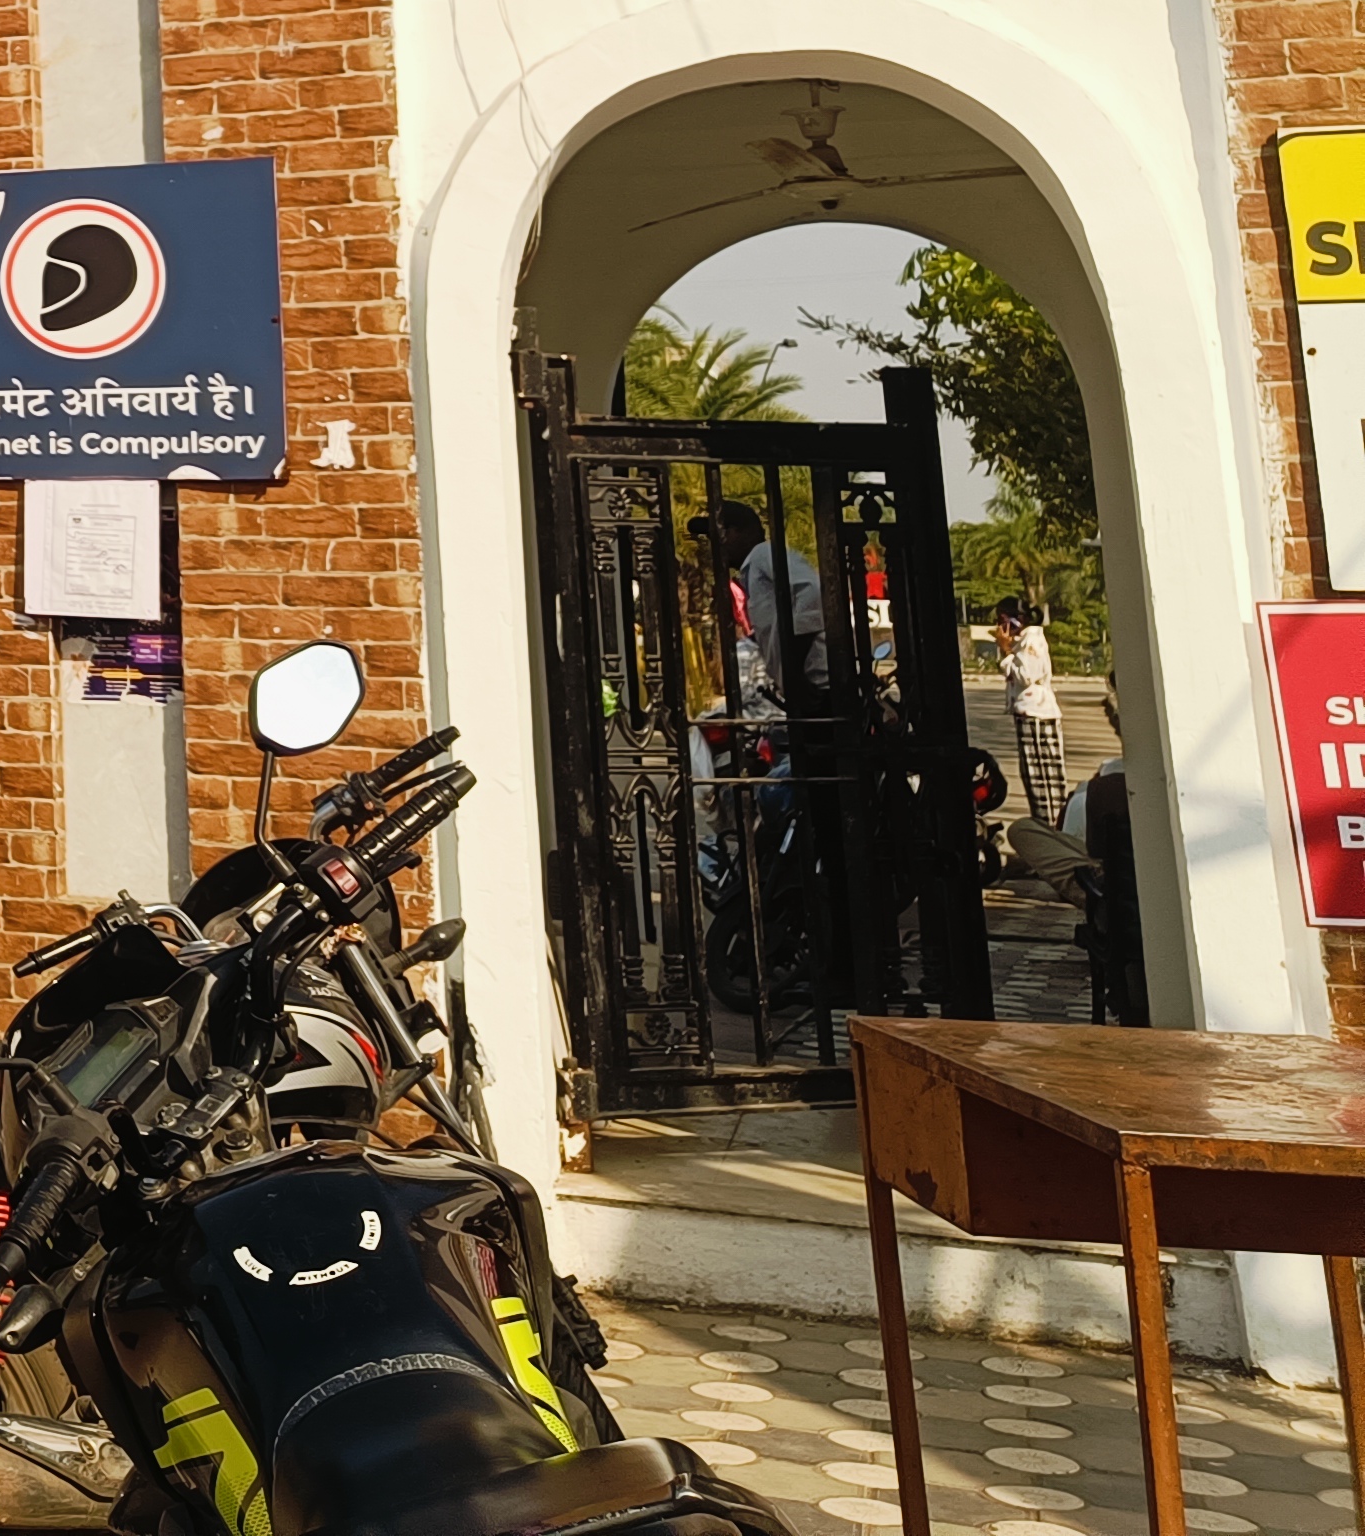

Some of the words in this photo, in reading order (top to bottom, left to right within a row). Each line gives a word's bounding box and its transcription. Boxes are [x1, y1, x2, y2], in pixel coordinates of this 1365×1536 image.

[1306, 220, 1365, 276] S
[60, 373, 202, 417] अनिवार्य
[48, 430, 73, 455] is
[79, 430, 266, 460] Compulsory
[244, 1259, 263, 1275] LIVE
[297, 1263, 351, 1282] WITHOUT
